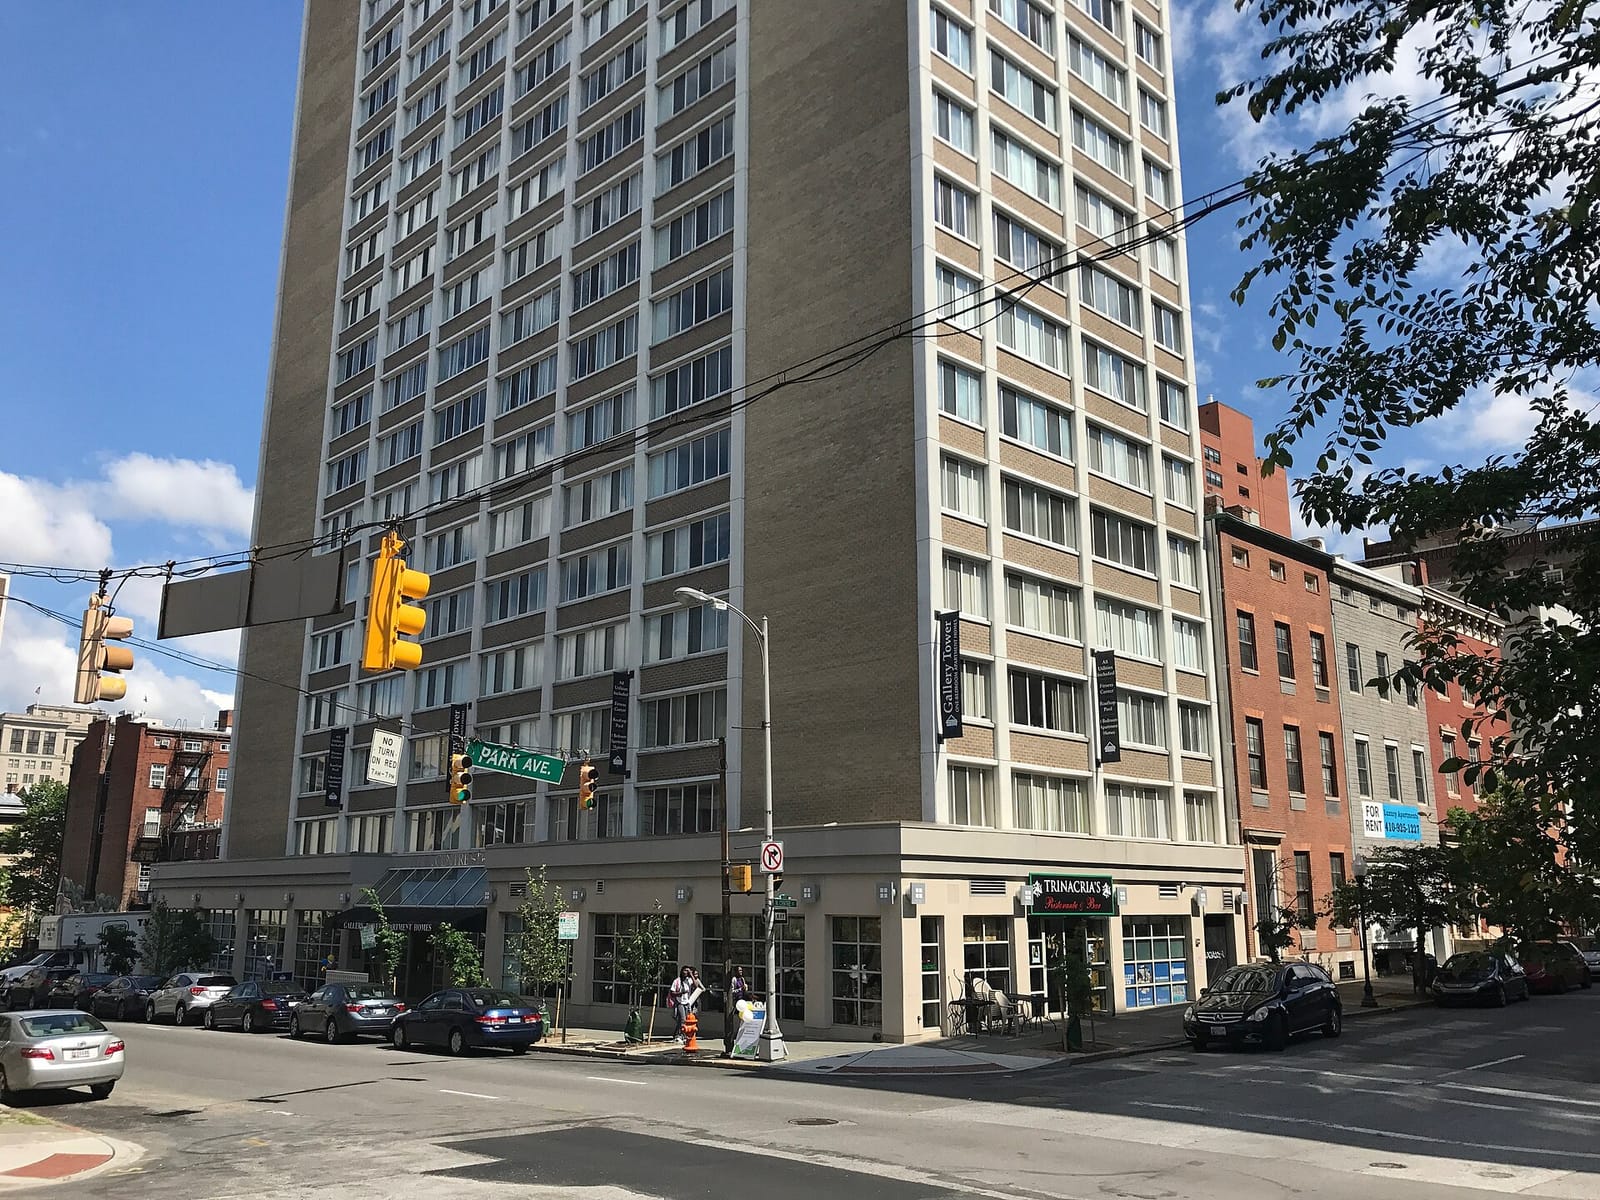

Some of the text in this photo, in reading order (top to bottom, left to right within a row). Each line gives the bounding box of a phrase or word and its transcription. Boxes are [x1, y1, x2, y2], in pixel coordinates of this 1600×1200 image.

[943, 621, 954, 713] Gallery Tower
[382, 737, 394, 747] NO
[378, 747, 395, 757] TURN
[371, 756, 398, 769] ON RED
[478, 746, 520, 770] PARK
[522, 758, 551, 776] AVE.
[1365, 805, 1380, 818] FOR
[1365, 819, 1382, 832] RENT
[1044, 879, 1101, 894] TRINACRIA'S
[1086, 896, 1102, 910] Bar
[413, 923, 432, 931] HOMES
